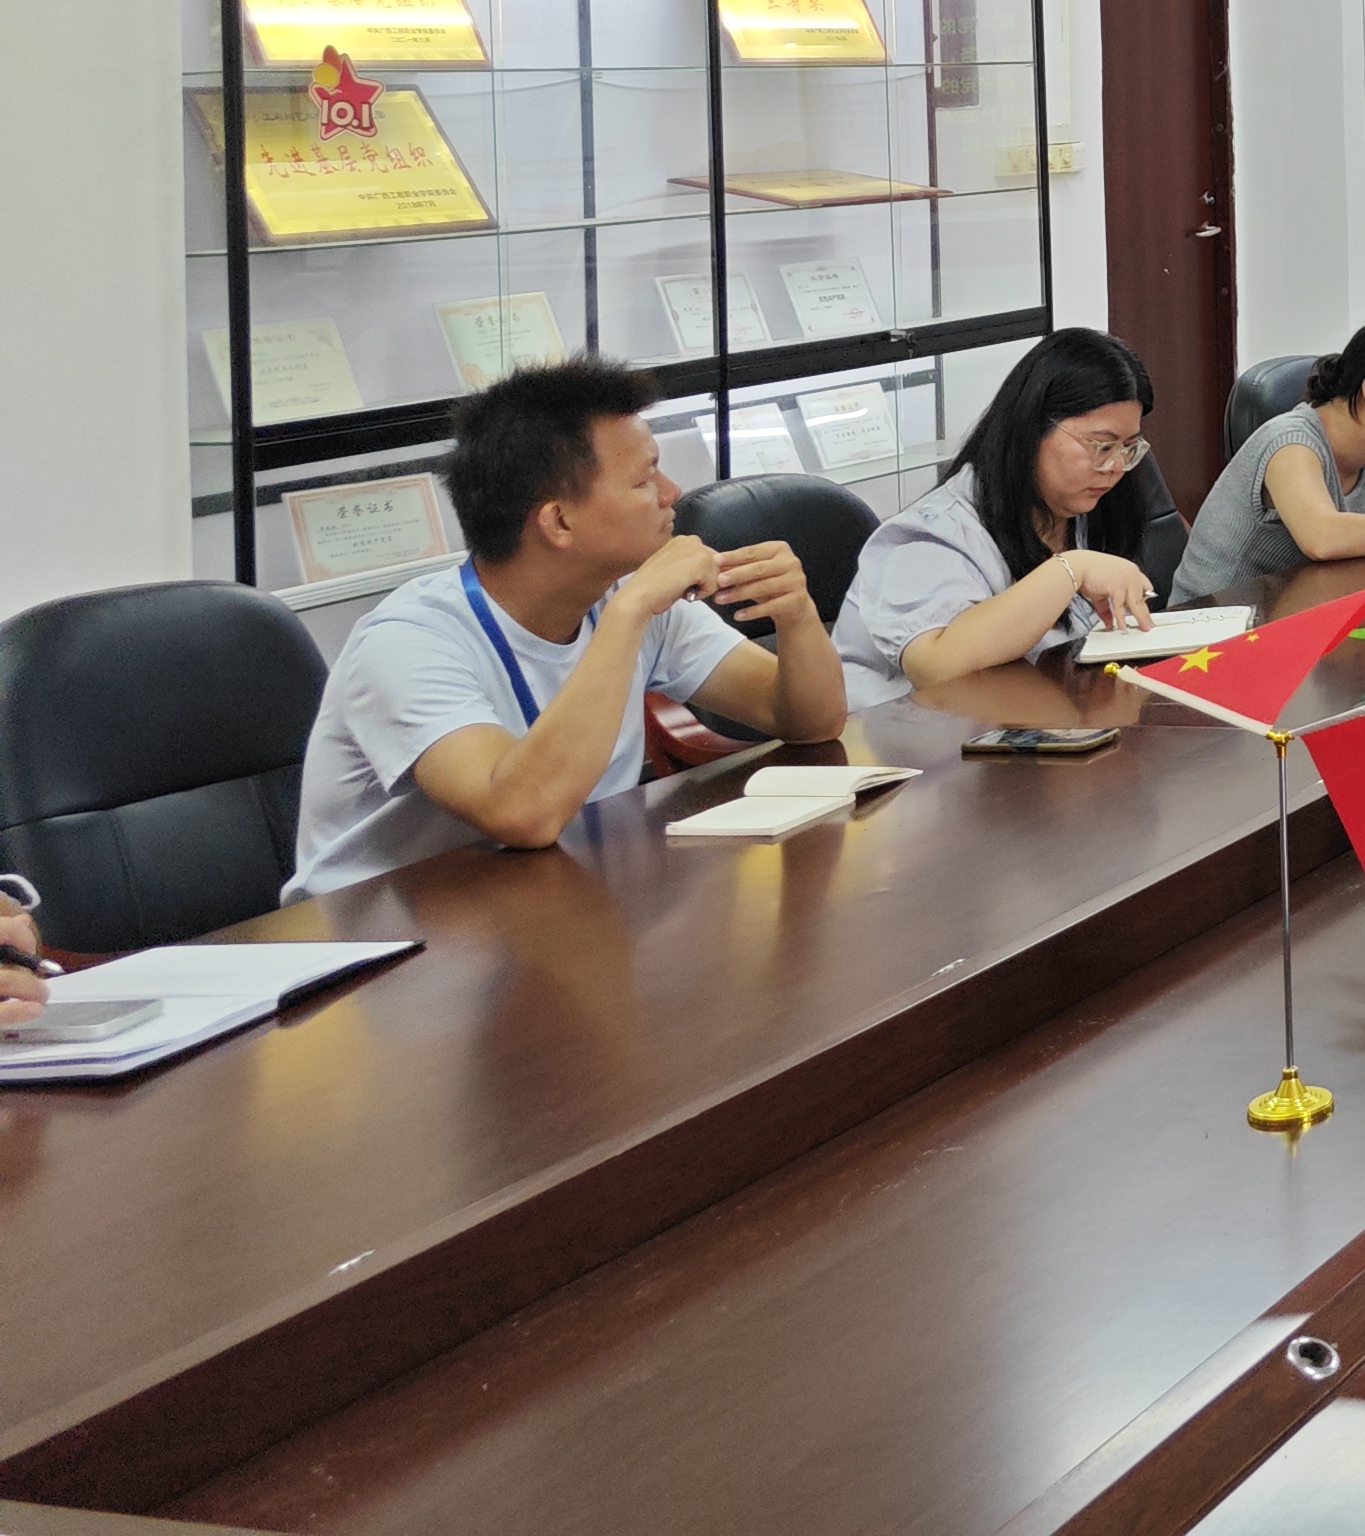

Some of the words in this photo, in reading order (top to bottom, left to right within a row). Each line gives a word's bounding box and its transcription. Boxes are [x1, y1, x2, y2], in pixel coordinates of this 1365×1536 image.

[261, 141, 434, 178] 先进基层党组织
